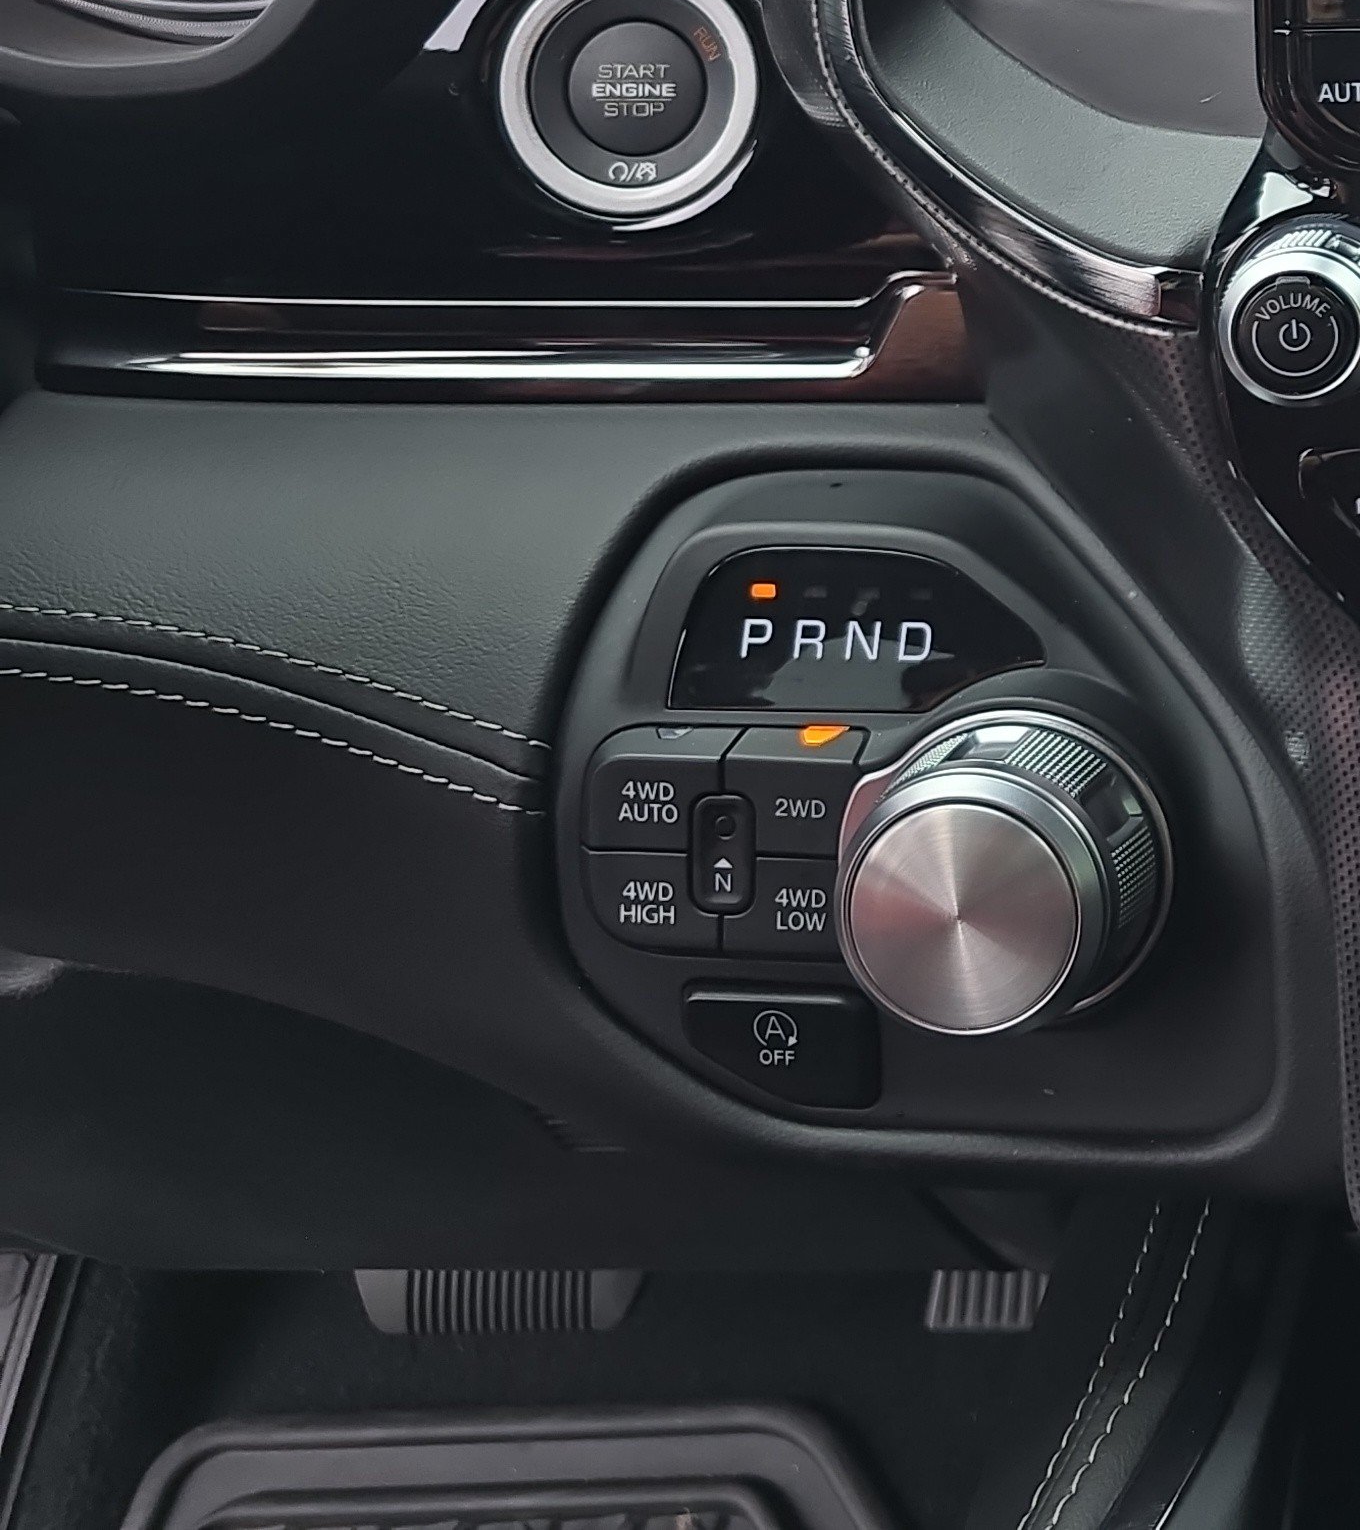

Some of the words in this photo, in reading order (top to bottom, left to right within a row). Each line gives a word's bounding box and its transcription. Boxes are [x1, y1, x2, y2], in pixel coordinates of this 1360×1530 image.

[598, 64, 670, 79] START
[592, 82, 676, 97] ENGINE
[604, 103, 664, 117] STOP
[1255, 292, 1331, 320] VOLUME
[740, 619, 773, 659] P
[792, 619, 827, 659] R
[844, 620, 882, 661] N
[898, 621, 932, 661] D
[621, 781, 674, 801] 4WD
[619, 803, 678, 824] AUTO
[775, 799, 826, 819] 2WD
[623, 882, 674, 902] 4WD
[715, 873, 732, 892] N
[775, 888, 826, 909] 4WD
[620, 904, 675, 924] HIGH
[776, 911, 826, 932] LOW
[759, 1048, 795, 1066] OFF
